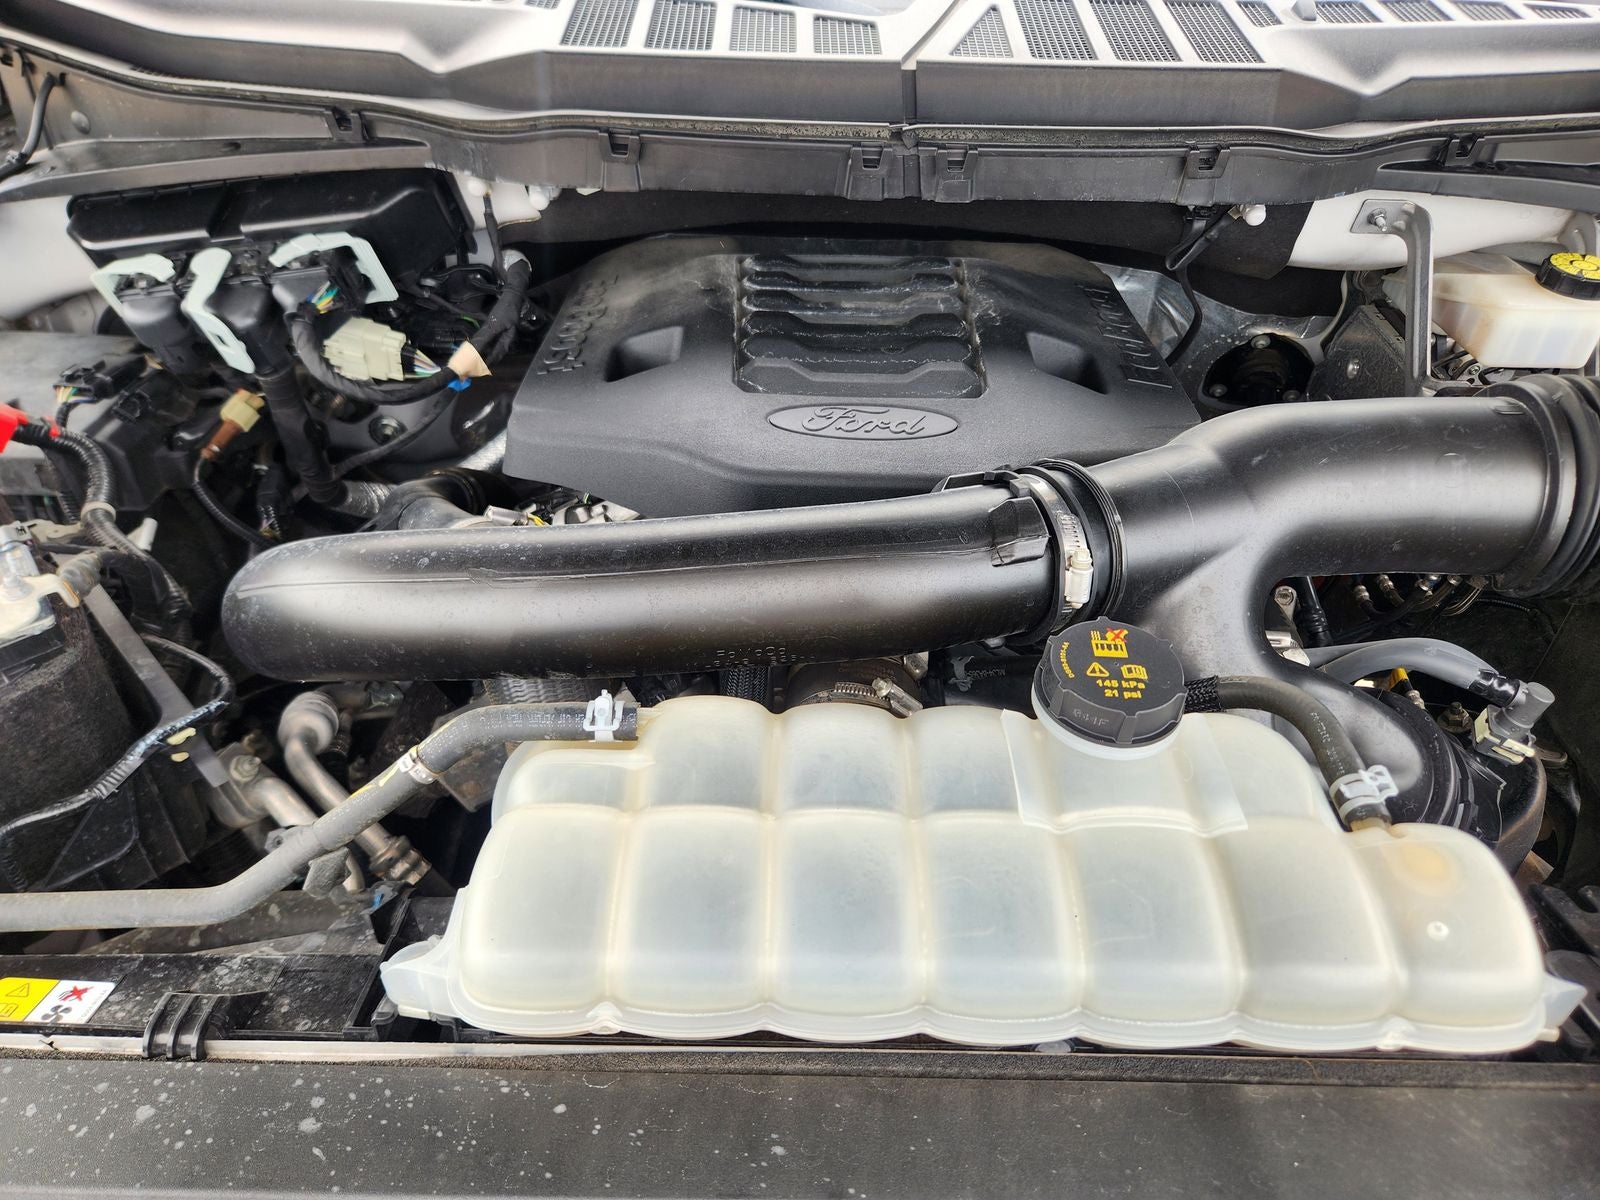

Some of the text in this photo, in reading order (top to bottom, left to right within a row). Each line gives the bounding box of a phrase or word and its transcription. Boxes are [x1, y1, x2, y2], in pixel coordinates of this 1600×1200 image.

[802, 407, 927, 436] Ford
[1096, 679, 1146, 689] 145 kPa
[1104, 689, 1142, 700] 21 psi
